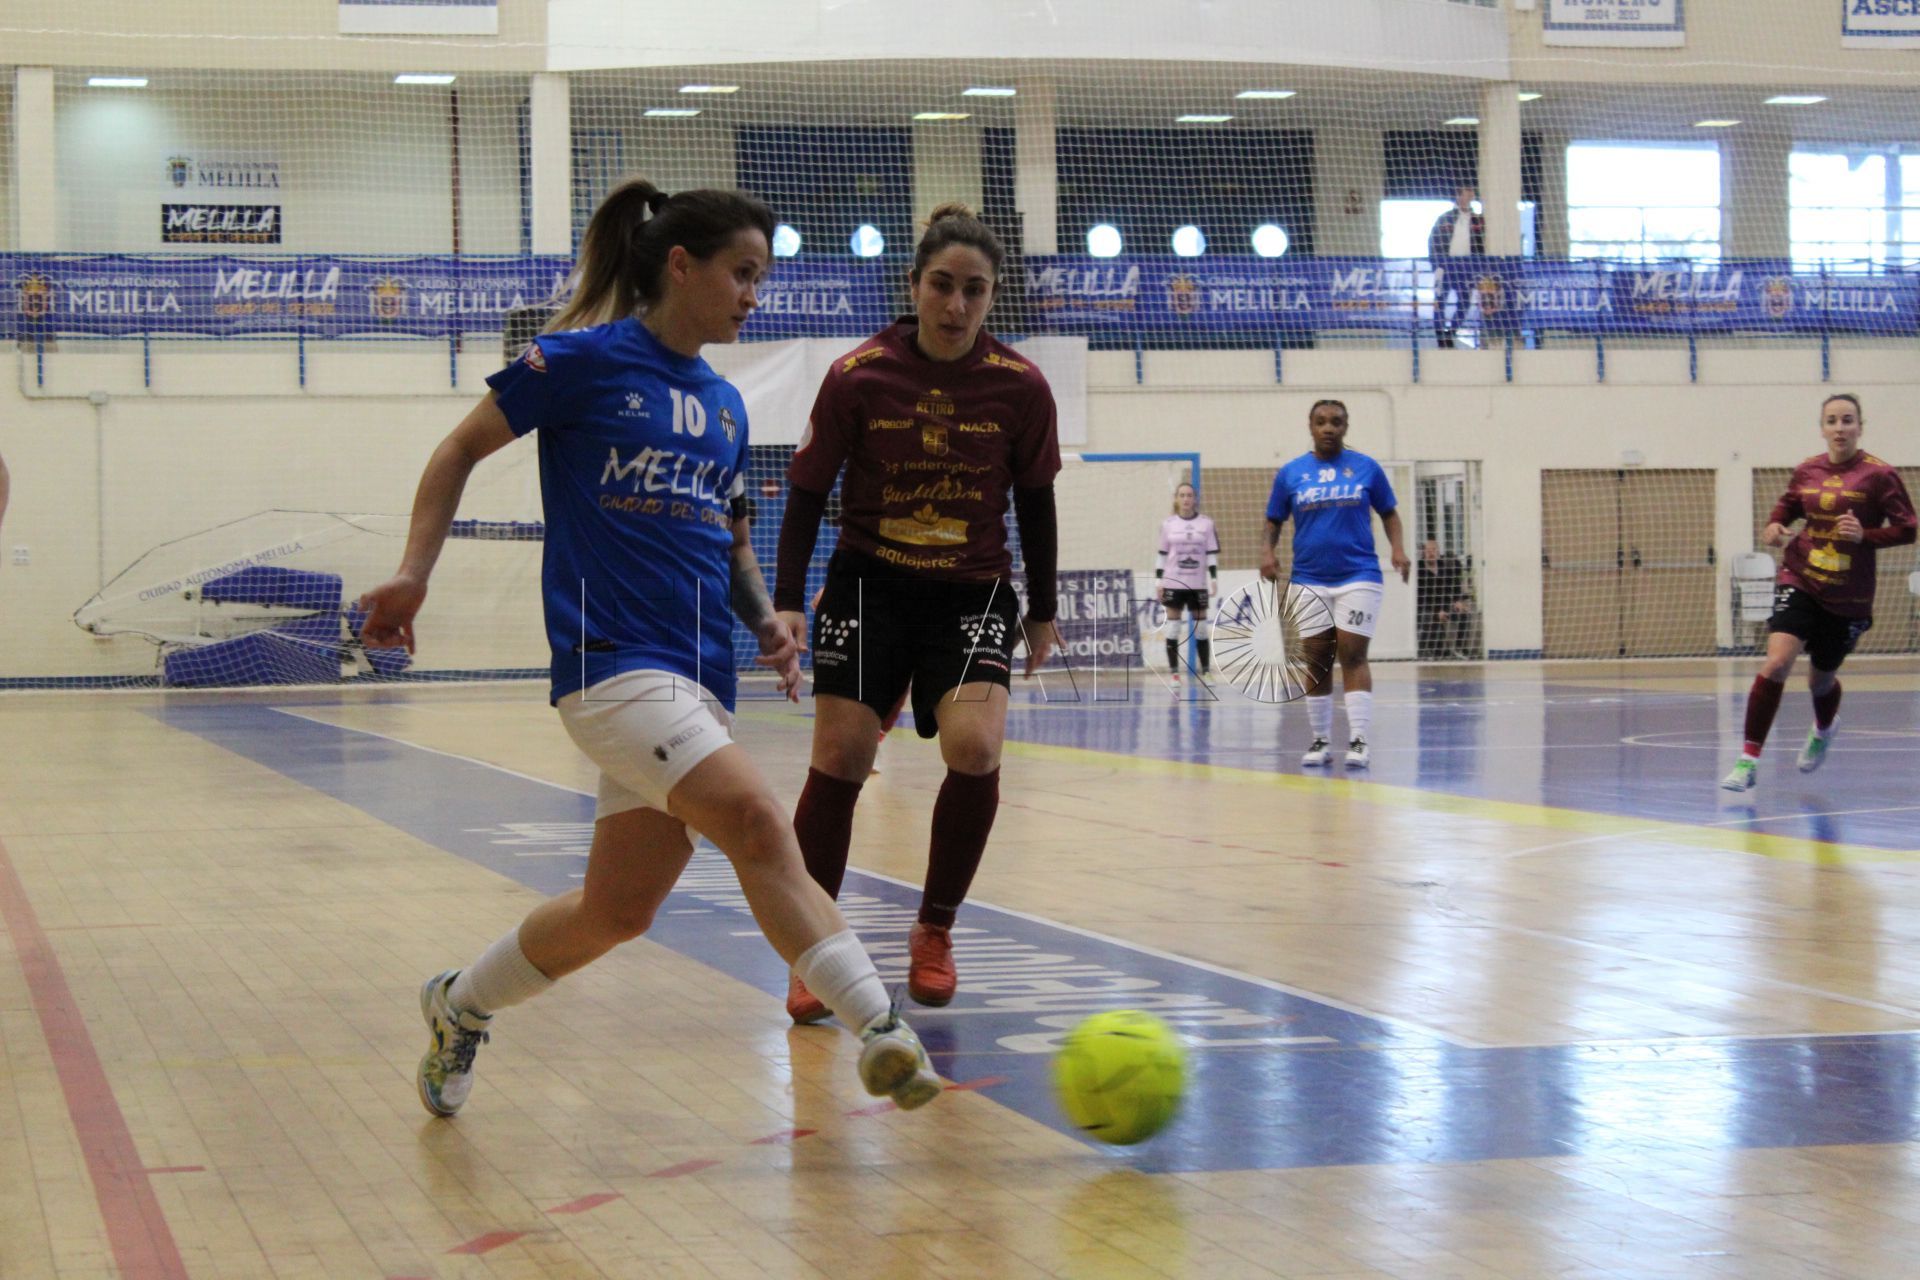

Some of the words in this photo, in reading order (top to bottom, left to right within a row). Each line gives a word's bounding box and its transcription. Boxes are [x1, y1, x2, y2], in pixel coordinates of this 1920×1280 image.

[198, 171, 281, 188] MELILLA
[167, 207, 275, 232] MELILLA
[214, 267, 339, 300] MELILLA
[1026, 266, 1139, 297] MELILLA
[1632, 271, 1743, 300] MELILLA
[70, 290, 181, 313] MELILLA
[420, 291, 525, 315] MELILLA
[1211, 288, 1311, 311] MELILLA
[1515, 289, 1613, 311] MELILLA
[1805, 289, 1898, 312] MELILLA
[669, 387, 706, 438] 10
[1318, 468, 1336, 483] 20
[1296, 484, 1364, 505] MELILLA
[875, 546, 960, 569] aquajerez
[138, 580, 182, 602] CIUDAD
[256, 542, 303, 564] MELILLA
[1084, 593, 1132, 619] SALA
[1347, 610, 1364, 626] 20
